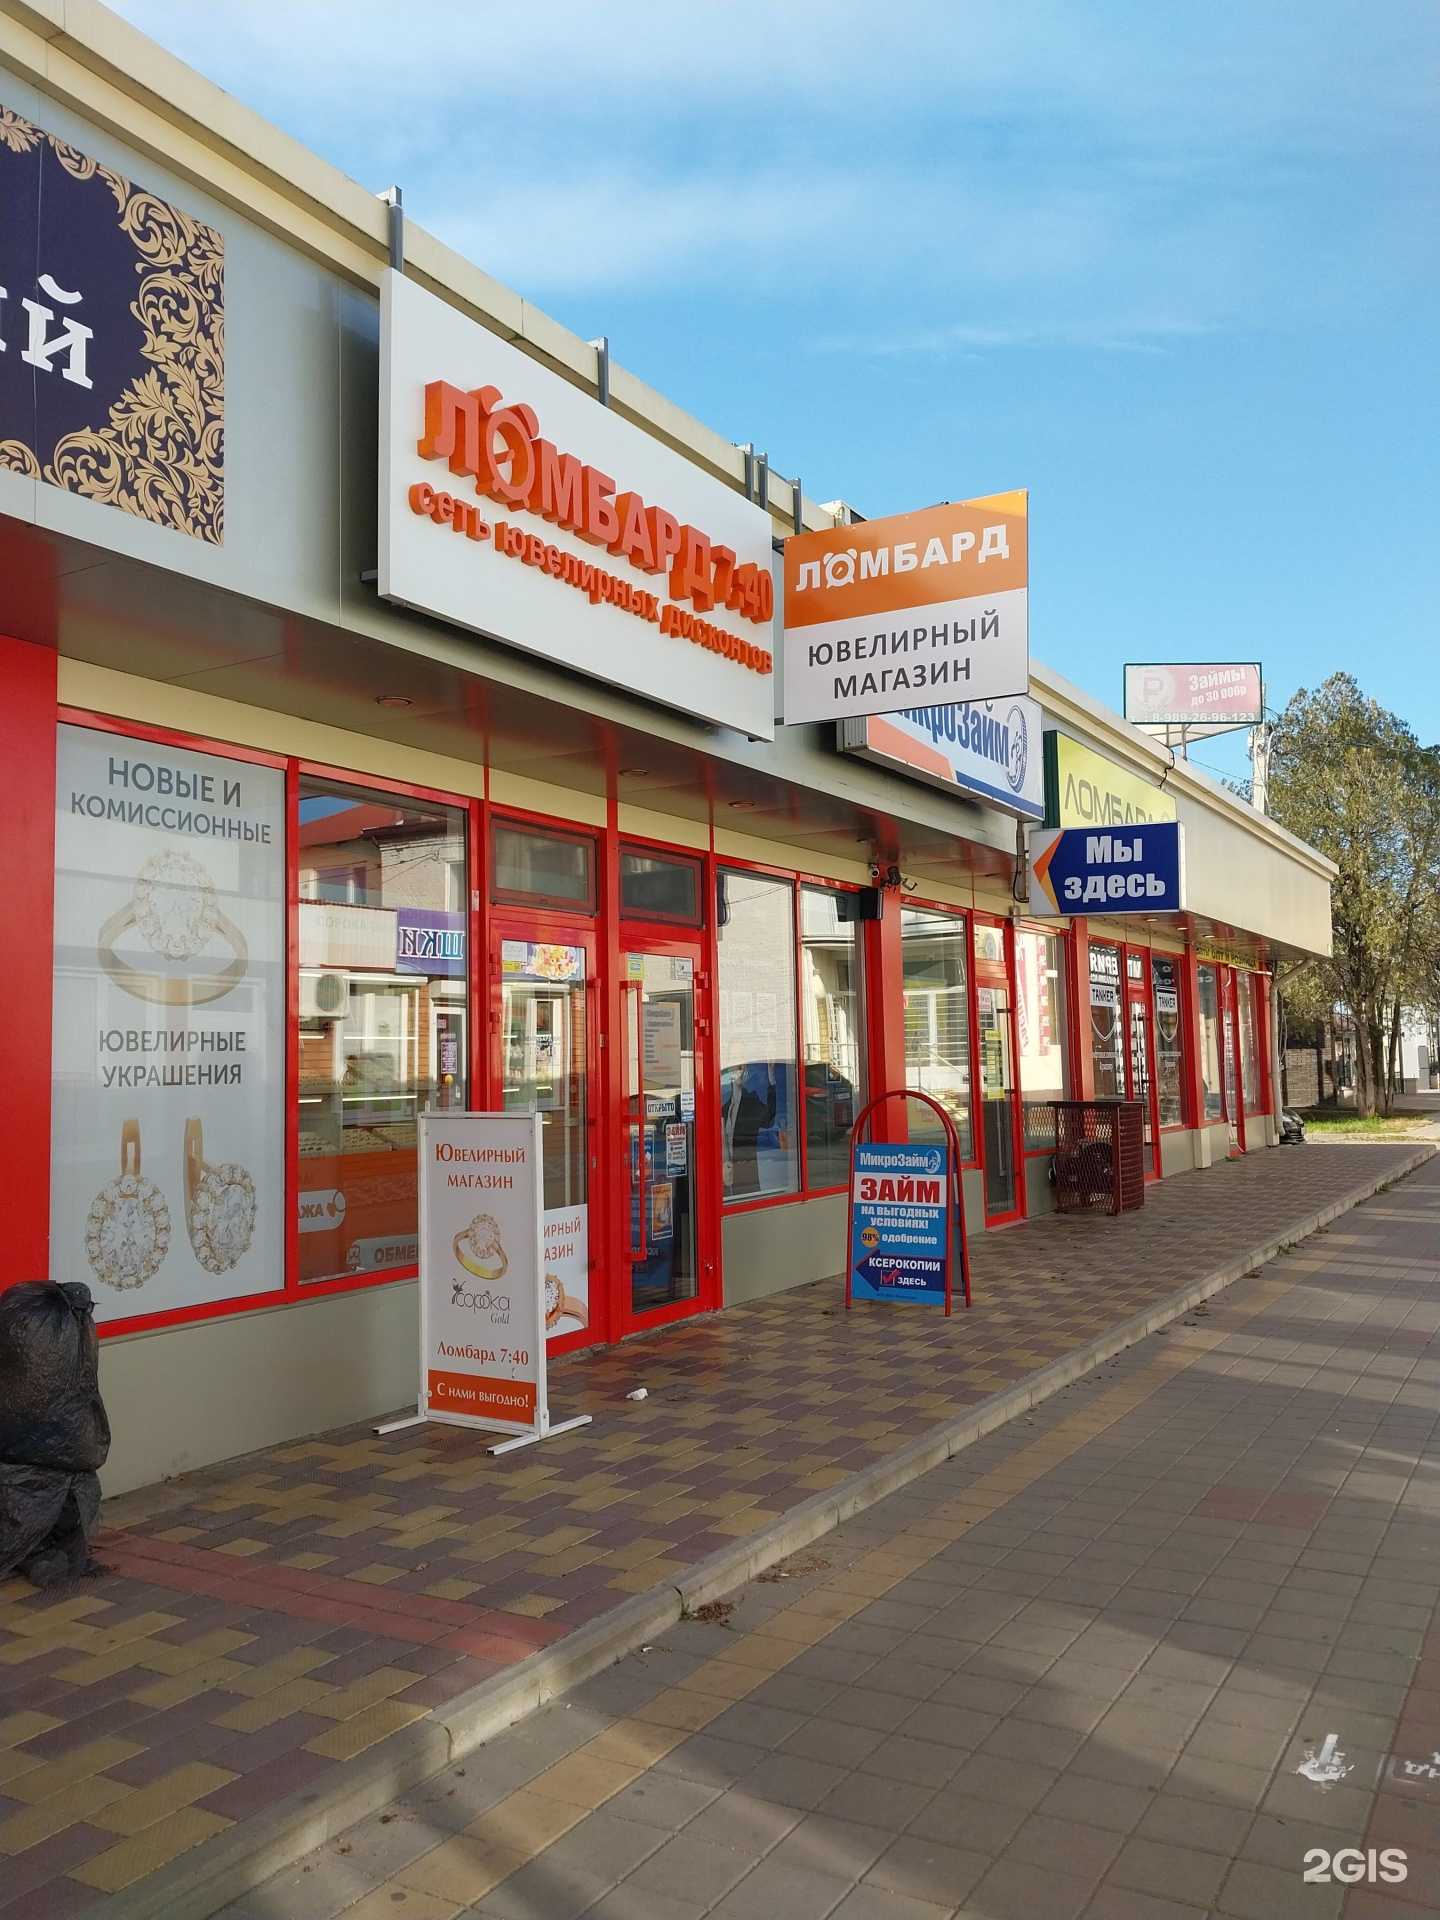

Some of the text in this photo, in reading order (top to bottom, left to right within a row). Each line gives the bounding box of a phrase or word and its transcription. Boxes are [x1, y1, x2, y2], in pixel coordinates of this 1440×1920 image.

[417, 380, 714, 612] ЛОМБАРД
[795, 524, 1009, 592] ЛОМБАРД
[495, 521, 660, 621] ювелирных
[660, 604, 772, 674] дисконтов
[808, 609, 999, 667] ЮВЕЛИРНЫЙ
[834, 658, 970, 699] МАГАЗИН
[108, 757, 242, 807] НОВЫЕ И
[71, 792, 271, 844] КОМИССИОННЫЕ
[1086, 835, 1143, 865] Мы
[1064, 873, 1166, 903] здесь
[100, 1030, 246, 1053] ЮВЕЛИРНЫЕ
[103, 1064, 242, 1088] УКРАШЕНИЯ
[648, 1102, 675, 1113] ОТКРЫТО
[860, 1152, 928, 1171] МикроЗайм
[861, 1175, 940, 1203] ЗАЙМ
[375, 1244, 418, 1263] ОБМЕ
[869, 1257, 941, 1271] КСЕРОКОПИИ
[437, 1341, 529, 1365] Ломбард 7:40
[437, 1383, 446, 1396] С
